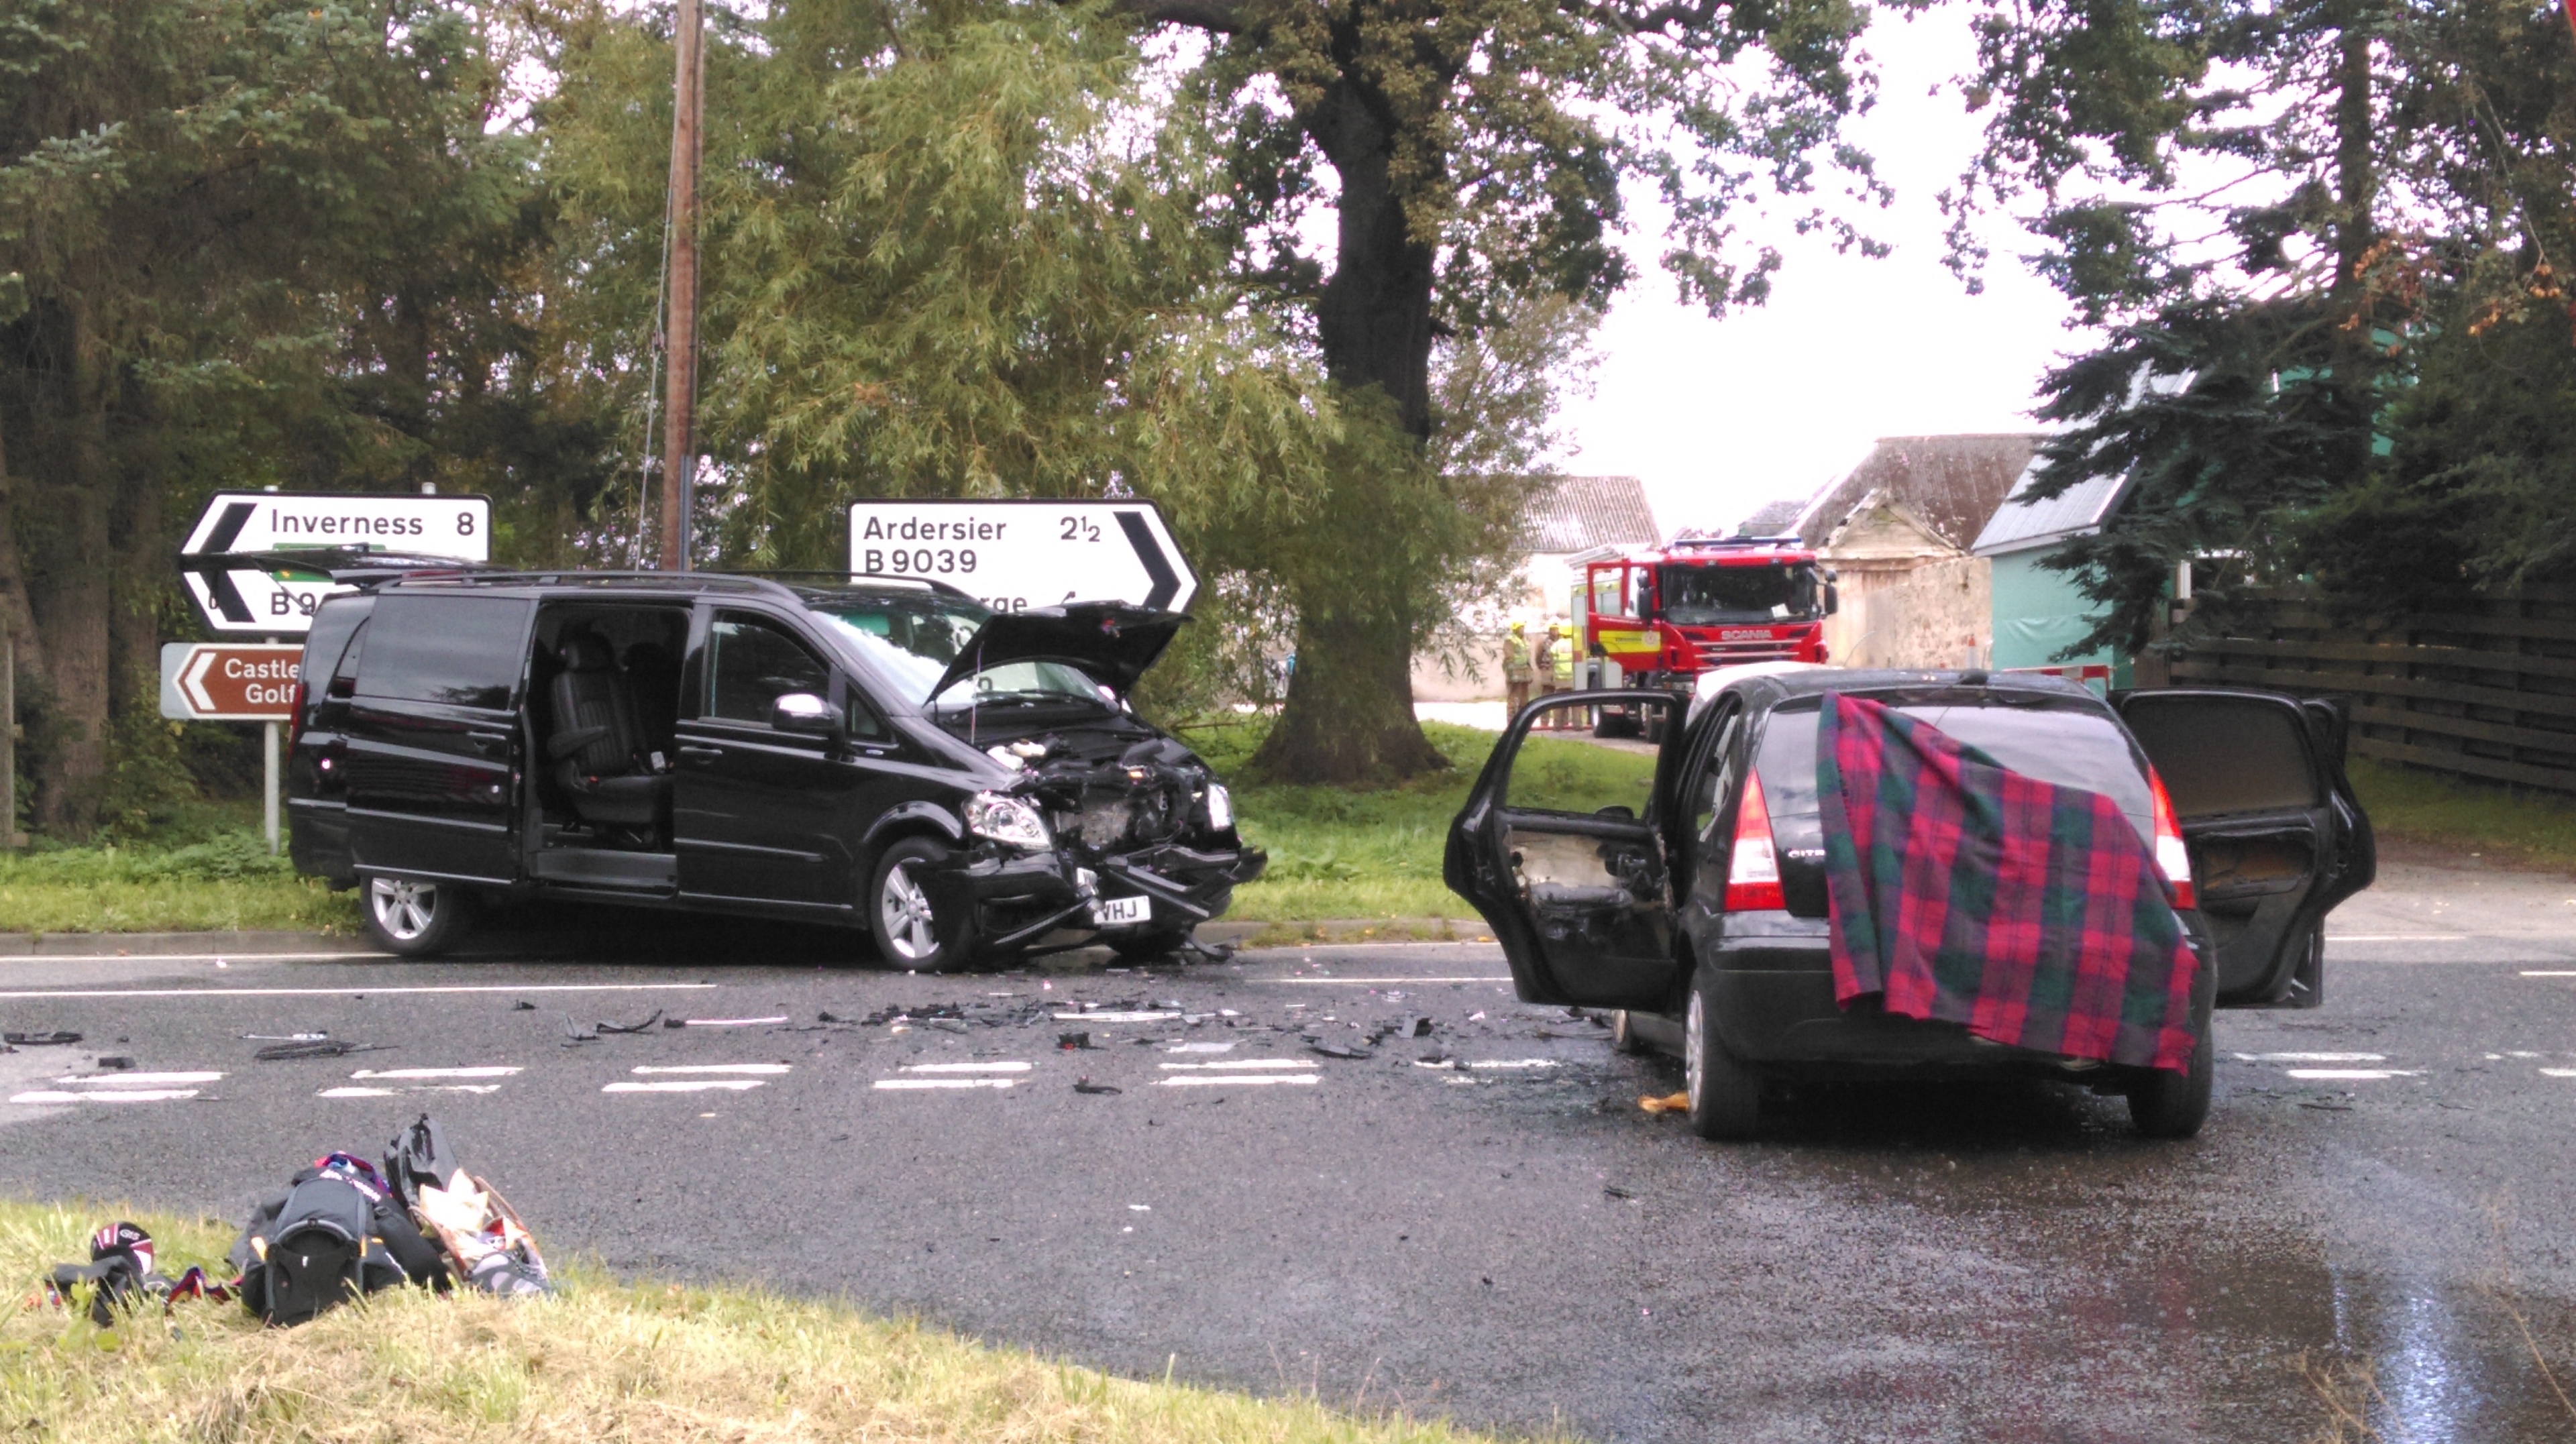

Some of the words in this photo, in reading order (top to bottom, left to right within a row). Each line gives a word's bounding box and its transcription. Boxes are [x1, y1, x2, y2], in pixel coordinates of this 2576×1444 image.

[272, 508, 423, 535] Inverness
[457, 512, 474, 536] 8
[863, 516, 1007, 540] Ardersier
[1721, 630, 1772, 640] SCANIA
[225, 658, 299, 678] Castle
[246, 683, 296, 704] Golf
